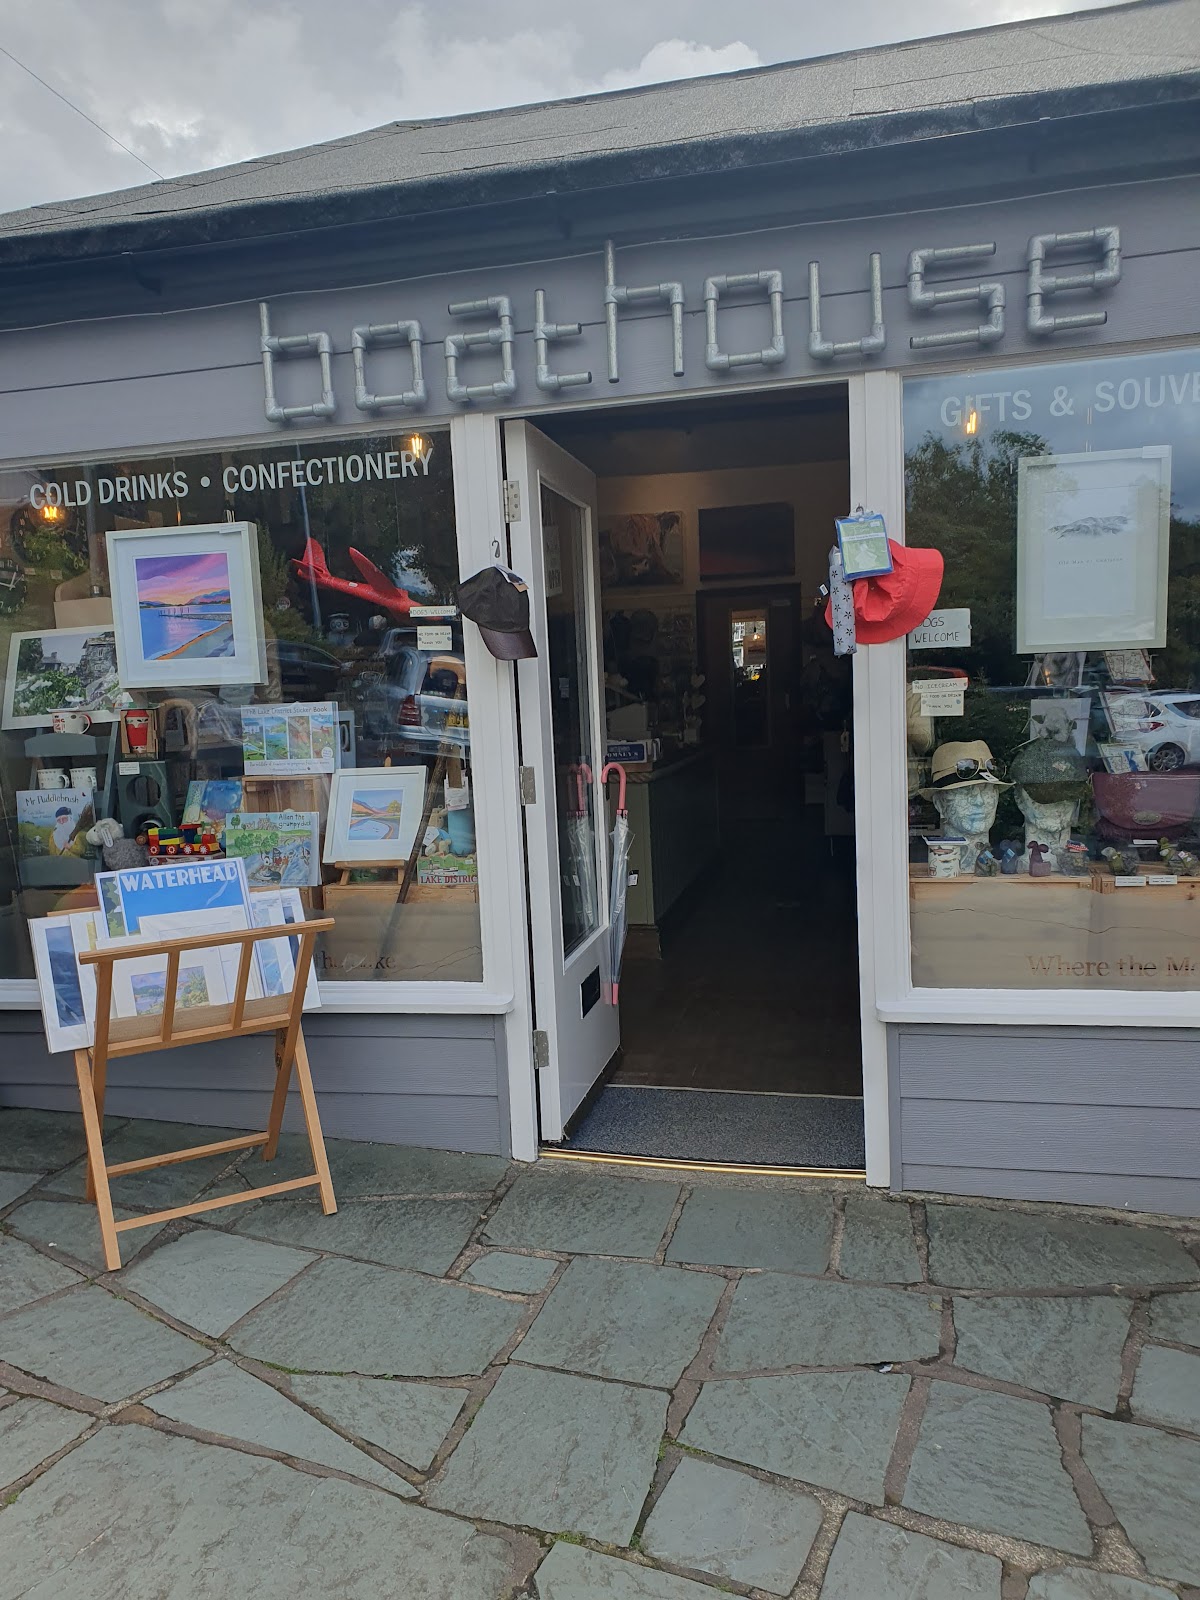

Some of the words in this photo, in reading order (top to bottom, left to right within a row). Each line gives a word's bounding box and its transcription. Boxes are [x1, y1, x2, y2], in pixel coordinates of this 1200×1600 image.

[258, 225, 1123, 424] boathouse
[940, 389, 1032, 427] GIFTS
[1049, 386, 1074, 417] &
[30, 481, 91, 510] COLD
[98, 471, 189, 505] DRINKS
[222, 449, 434, 493] CONFECTIONERY
[917, 616, 945, 628] OGS
[914, 632, 960, 643] WELCOME
[293, 706, 312, 714] Sticker
[278, 821, 300, 829] grumpy
[120, 862, 238, 893] WATERHEAD
[420, 875, 443, 884] LAKE
[1026, 953, 1110, 977] Where
[1117, 953, 1157, 977] the
